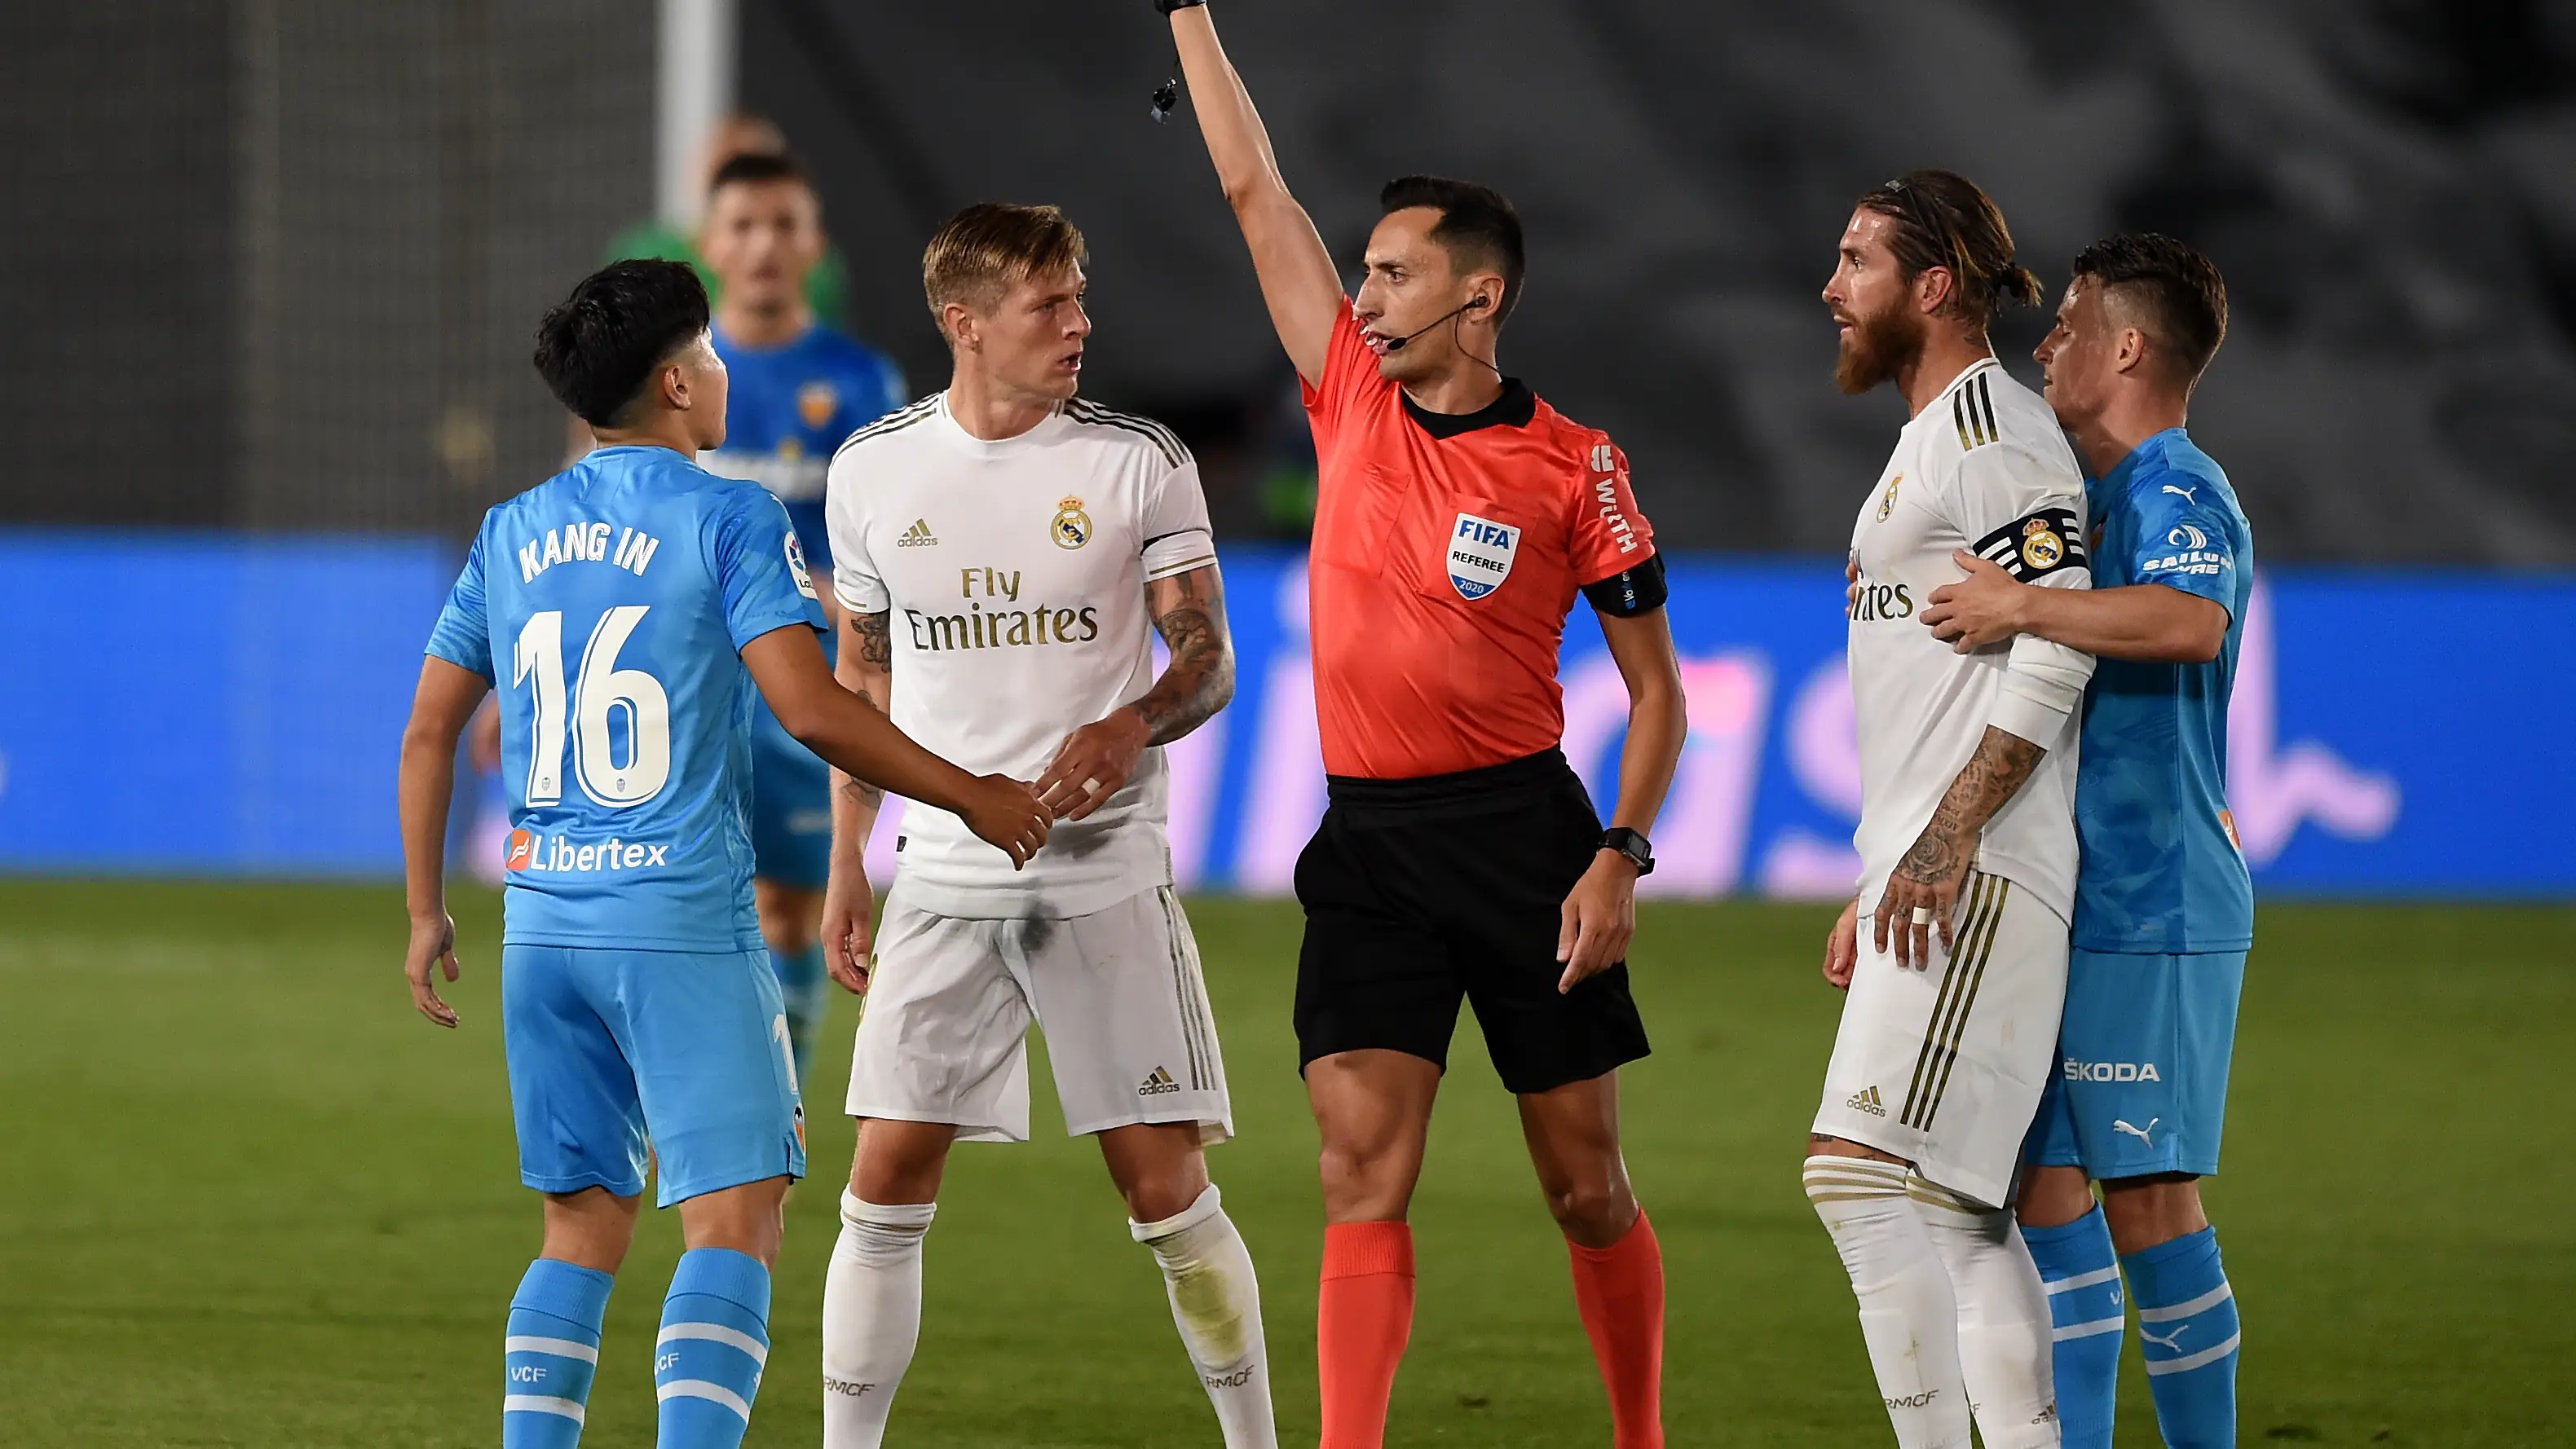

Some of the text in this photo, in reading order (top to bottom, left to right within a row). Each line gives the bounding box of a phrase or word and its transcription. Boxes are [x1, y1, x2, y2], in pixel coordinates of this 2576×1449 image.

[897, 535, 938, 548] adidas
[1458, 519, 1510, 550] FIFA
[518, 521, 660, 584] KANG IN
[1451, 550, 1506, 574] REFEREE
[961, 566, 1021, 603] Fly
[1458, 579, 1484, 595] 2020
[904, 602, 1099, 652] Emirates
[513, 605, 671, 808] 16
[530, 835, 669, 872] Libertex
[2063, 1057, 2161, 1082] ŠKODA
[1138, 1083, 1180, 1096] adidas
[1846, 1099, 1887, 1118] adidas
[510, 1366, 547, 1383] VCF
[823, 1376, 876, 1397] RMCF
[1206, 1364, 1255, 1389] RMCF
